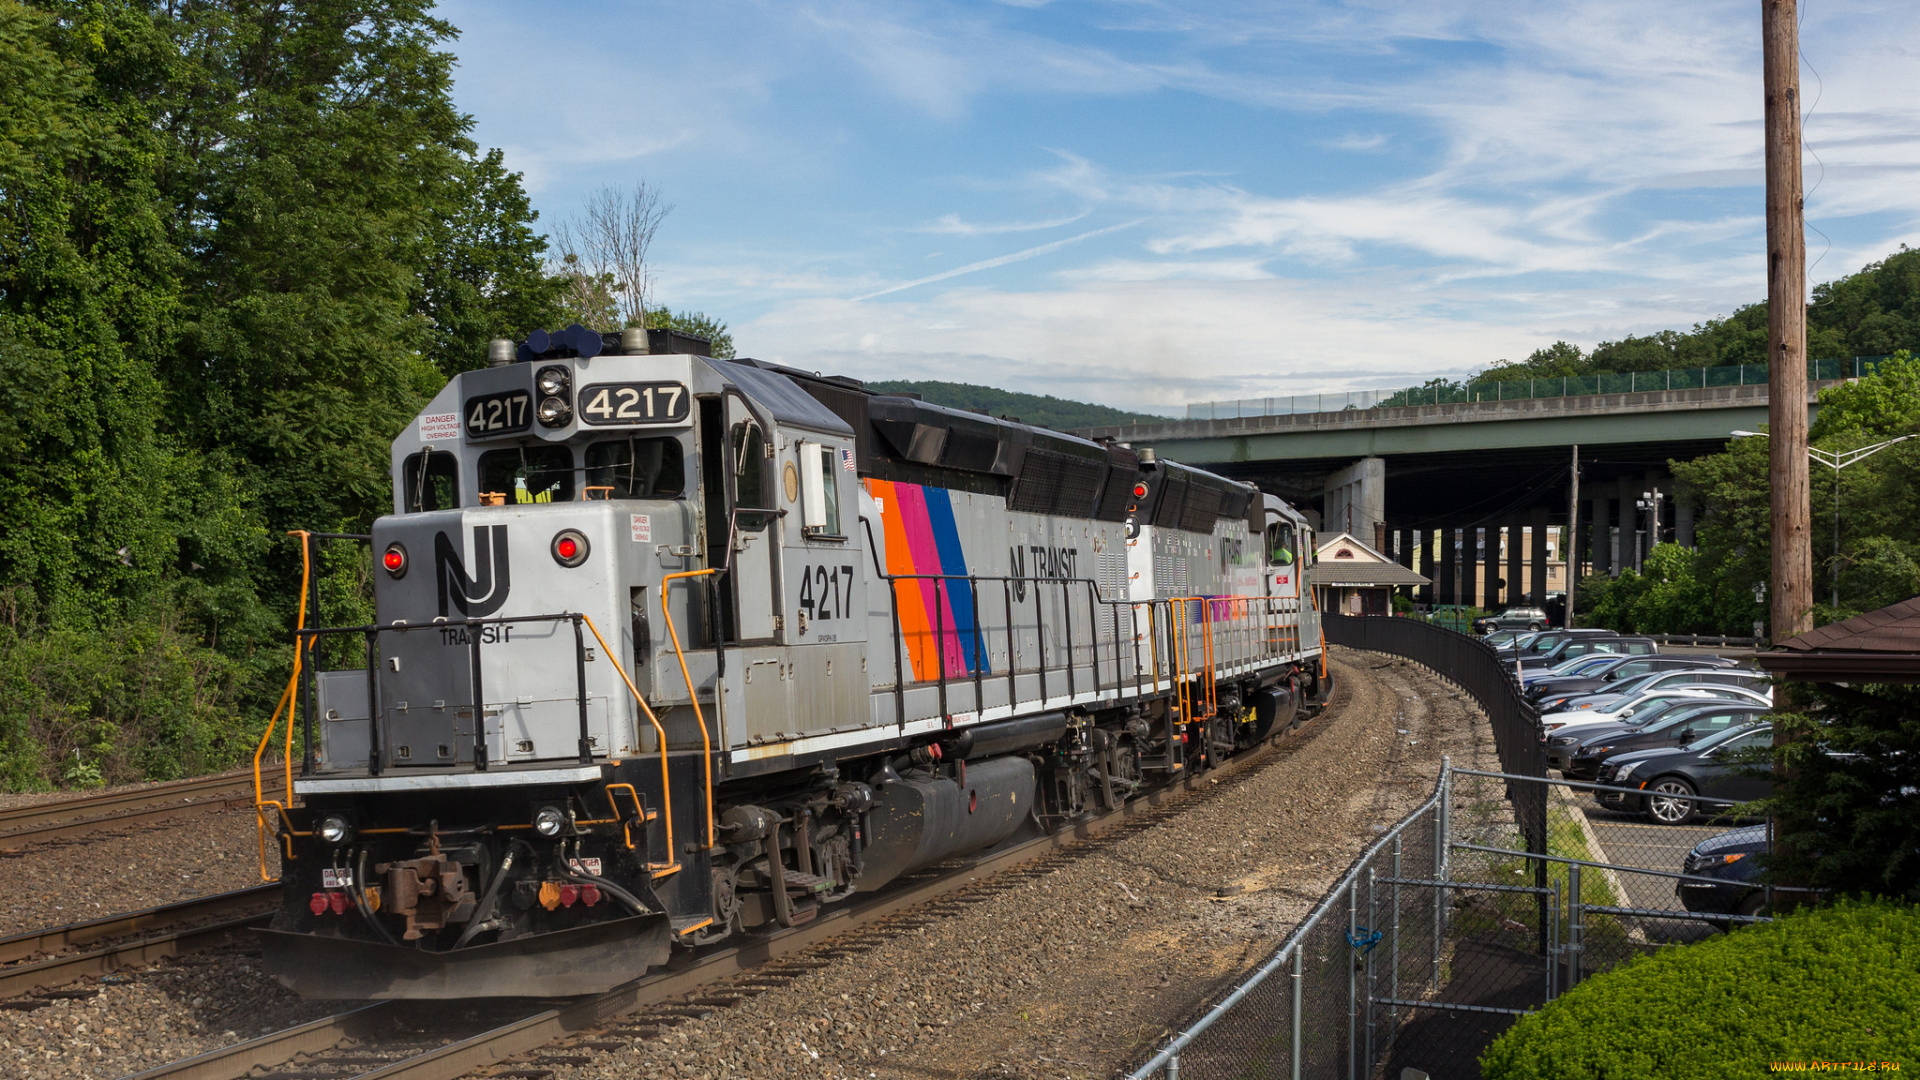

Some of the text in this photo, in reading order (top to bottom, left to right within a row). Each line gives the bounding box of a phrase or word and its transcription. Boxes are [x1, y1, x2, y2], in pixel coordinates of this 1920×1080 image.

[469, 395, 528, 431] 4217
[585, 386, 682, 419] 4217
[425, 414, 456, 424] DANGER
[436, 422, 462, 431] VOLTAGE
[426, 431, 457, 440] OVERHEAD
[1031, 546, 1078, 585] TRANSIT
[800, 565, 854, 621] 4217
[439, 626, 514, 646] TRASIT
